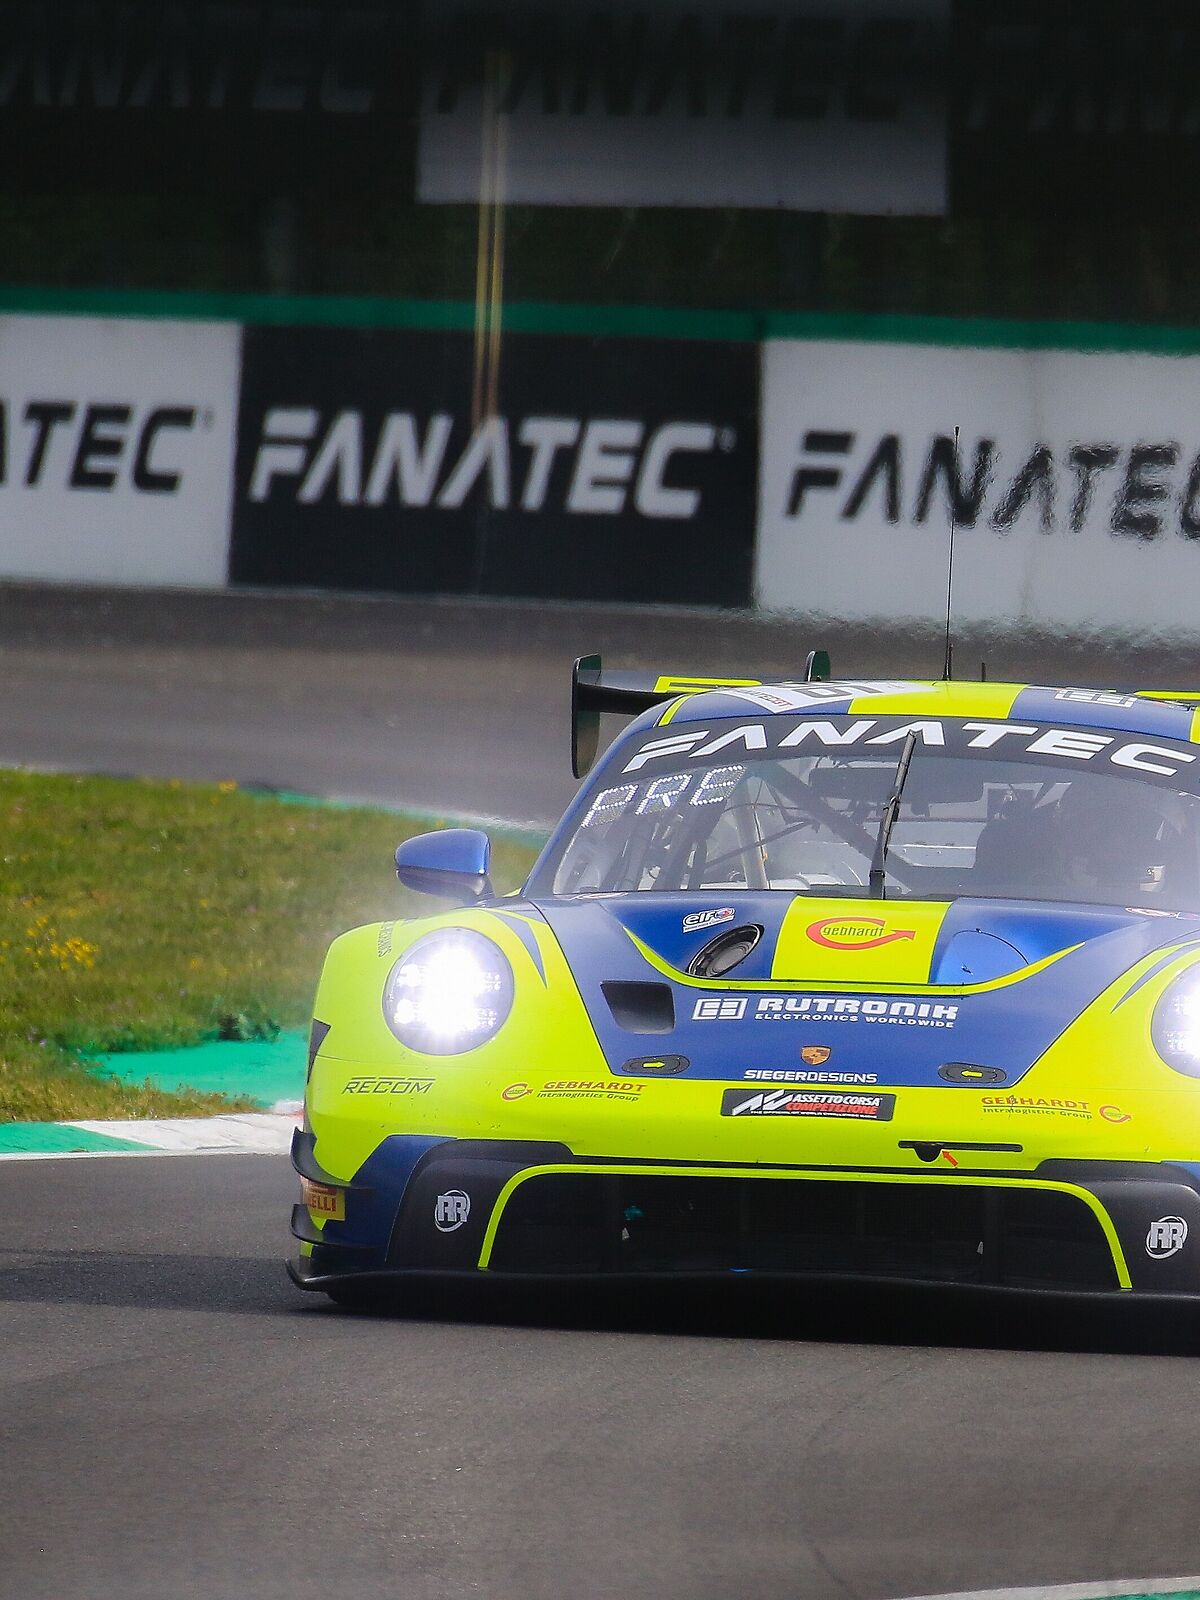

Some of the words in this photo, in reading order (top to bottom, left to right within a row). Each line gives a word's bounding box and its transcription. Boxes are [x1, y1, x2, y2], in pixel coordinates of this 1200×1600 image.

[249, 406, 715, 519] FANATEC
[621, 719, 1197, 777] FANATEC
[580, 764, 747, 828] PRE
[757, 997, 959, 1020] RUTRONIK
[754, 1013, 858, 1023] ELECTRONICS
[865, 1016, 955, 1029] WORLDWIDE
[743, 1069, 879, 1084] SIEGERDESIGNS
[342, 1078, 436, 1095] RECOM
[543, 1081, 648, 1093] GEBHARDT
[606, 1093, 640, 1102] Group
[981, 1096, 1090, 1110] GEBHARDT
